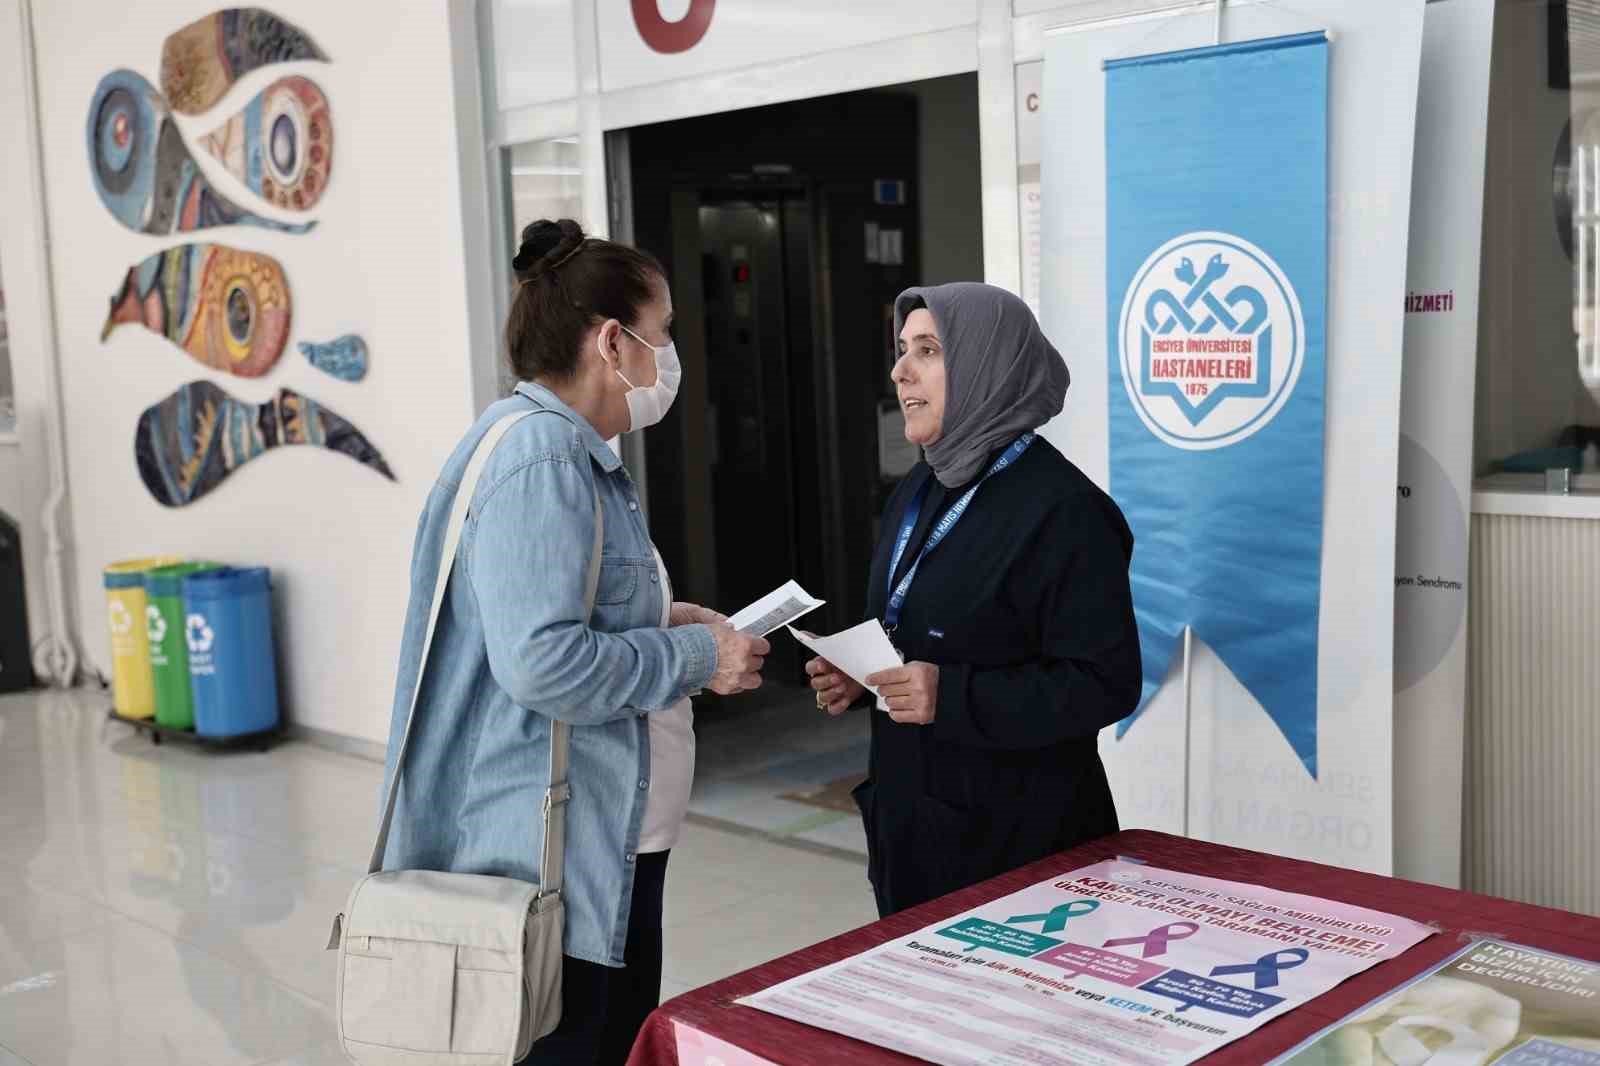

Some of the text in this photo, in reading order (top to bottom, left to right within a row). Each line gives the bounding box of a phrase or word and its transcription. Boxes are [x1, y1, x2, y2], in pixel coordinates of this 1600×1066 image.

[1186, 337, 1252, 353] ÜNİVERSİTESİ
[1152, 356, 1252, 378] HASTANELERİ
[1053, 880, 1132, 904] ÜCRETSİZ
[1132, 899, 1202, 921] KANSER
[1075, 876, 1165, 900] KANSER
[1166, 896, 1255, 922] OLMAYI
[1283, 908, 1393, 936] MÜDÜRLÜĞÜ
[1471, 952, 1583, 985] BİZİM İÇİN
[1484, 944, 1599, 976] HAYATINIZ
[1007, 966, 1075, 992] Hekiminize
[1074, 988, 1106, 1001] veya
[1162, 1012, 1228, 1036] başvurun
